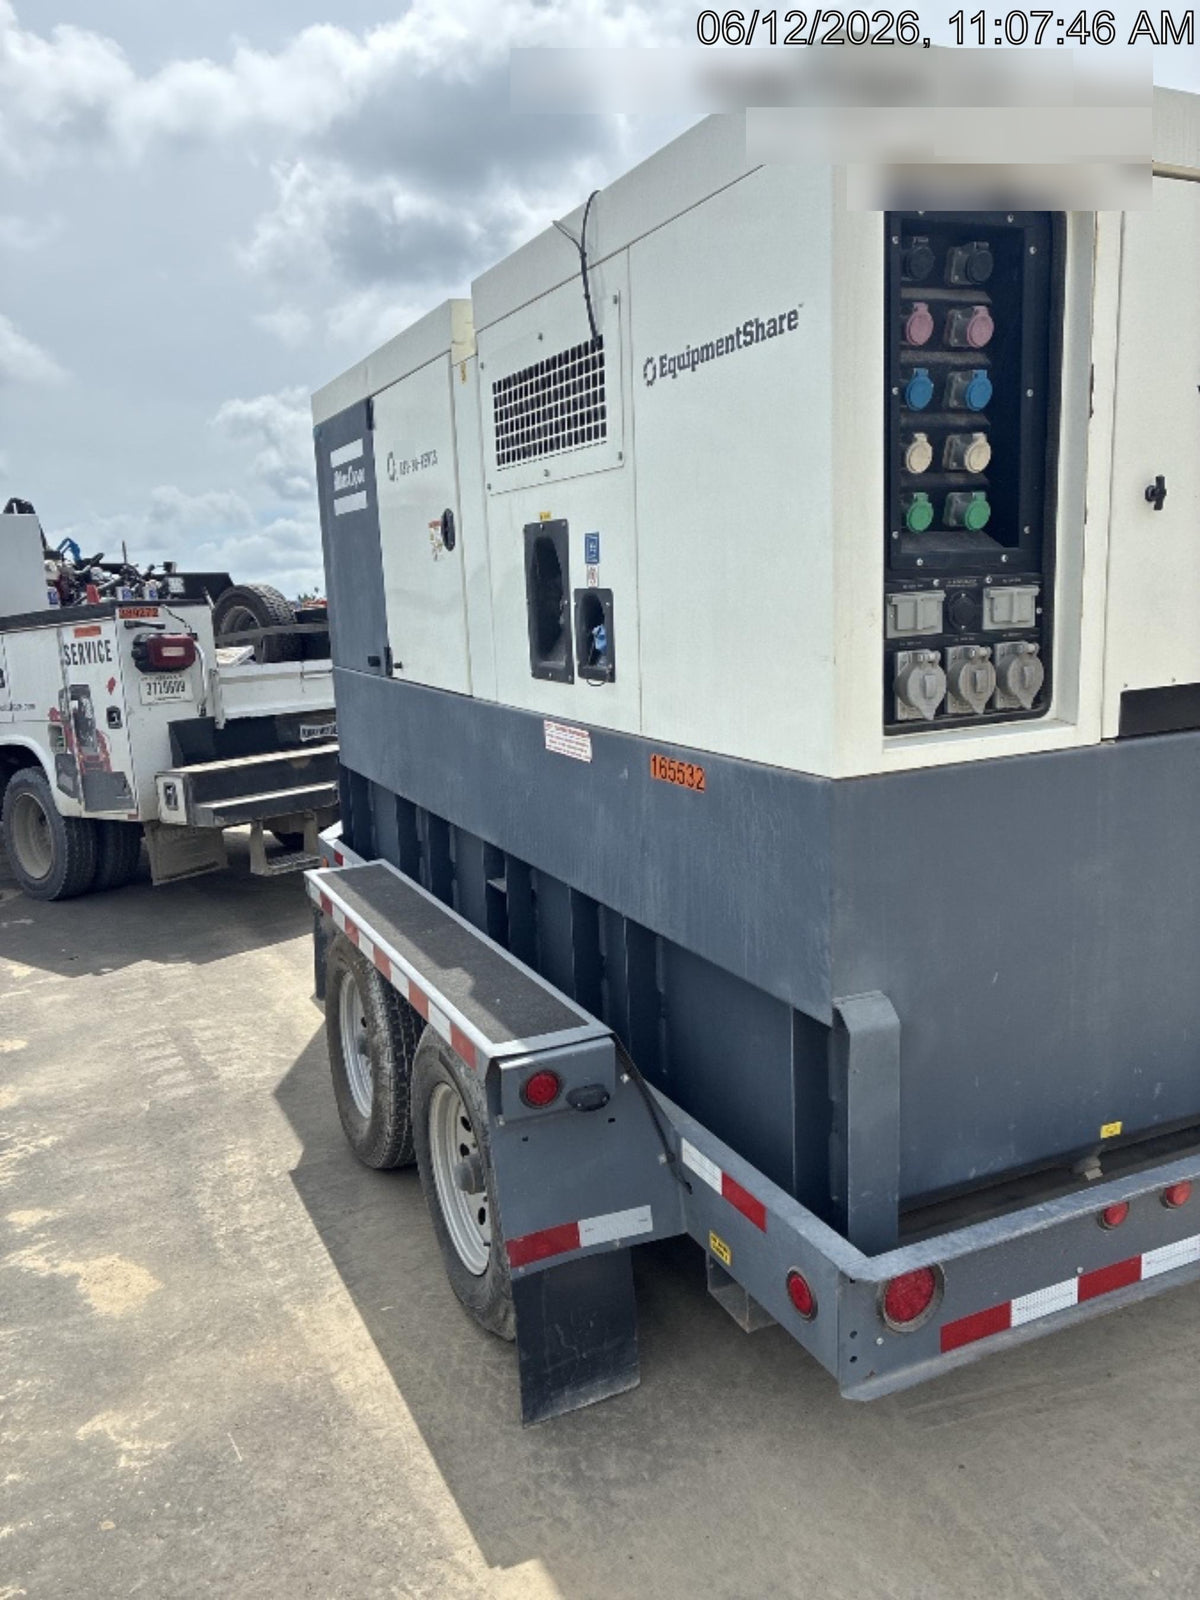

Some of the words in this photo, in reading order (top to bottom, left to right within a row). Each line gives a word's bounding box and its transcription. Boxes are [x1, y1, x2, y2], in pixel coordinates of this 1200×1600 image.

[659, 308, 800, 379] EquipmentShare
[63, 640, 113, 665] SERVICE
[651, 754, 706, 791] 165532
